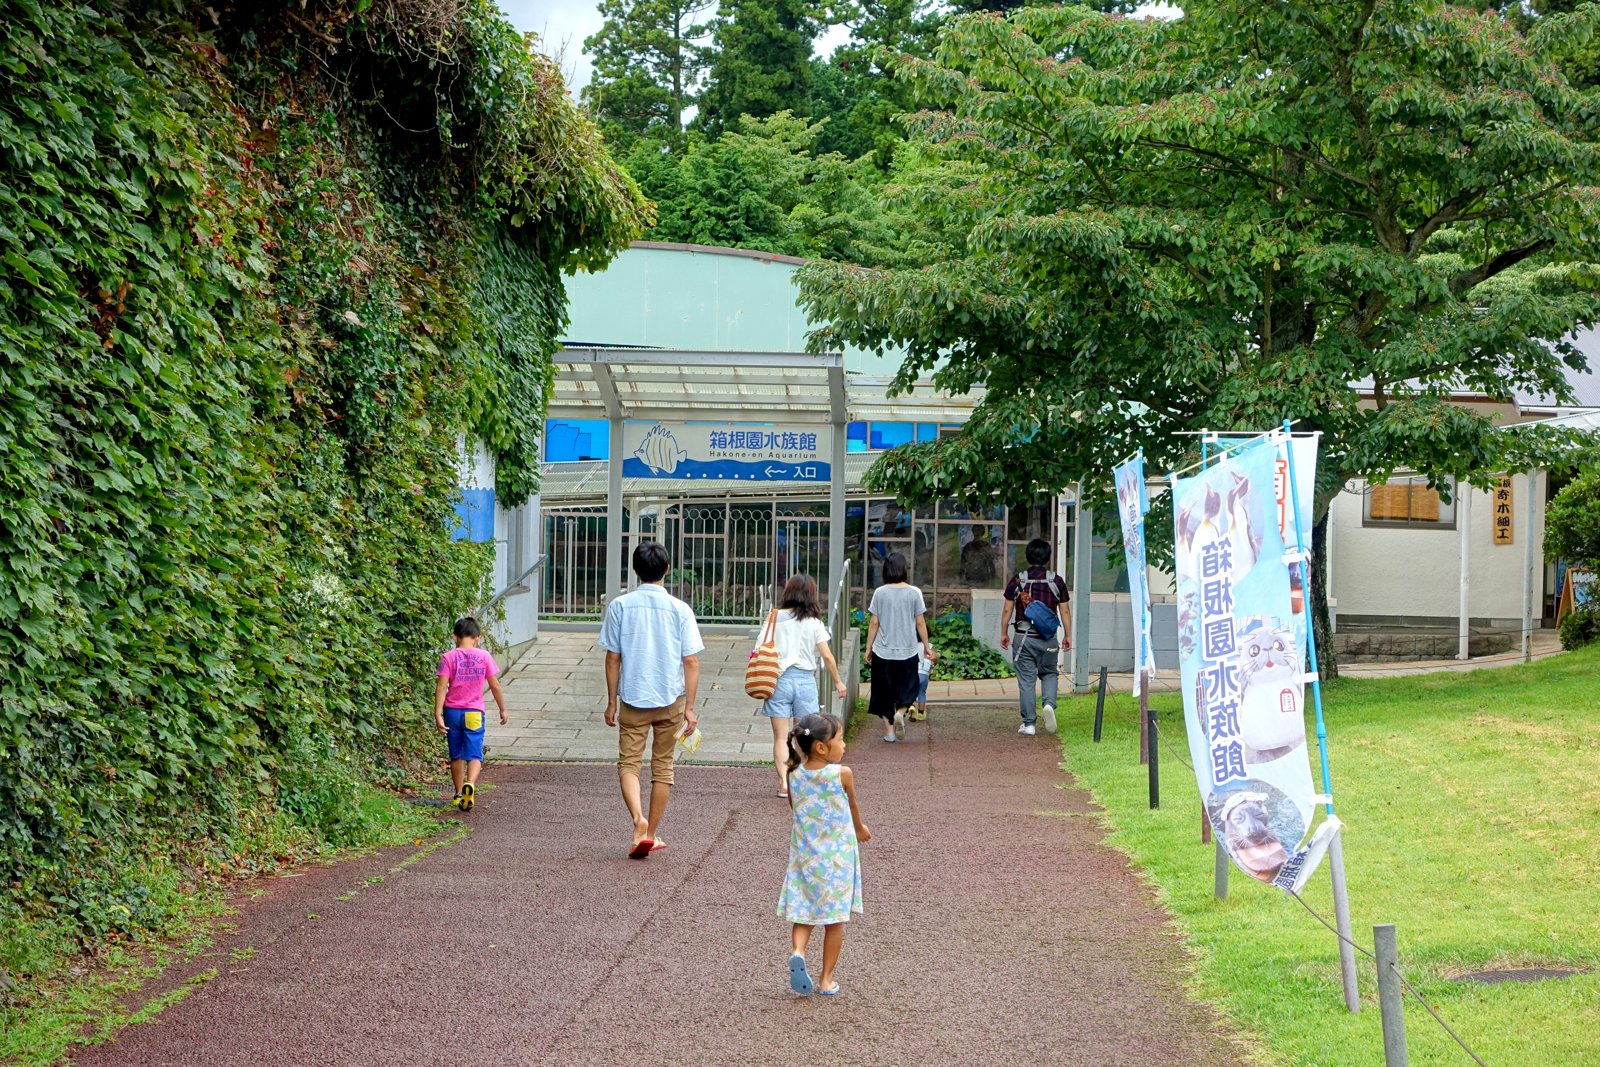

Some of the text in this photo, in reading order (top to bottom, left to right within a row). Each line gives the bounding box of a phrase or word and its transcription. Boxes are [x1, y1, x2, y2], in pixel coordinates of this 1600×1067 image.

[710, 431, 817, 451] 箱根園水族館
[793, 466, 817, 478] 入口
[1496, 489, 1510, 540] 寄木細工
